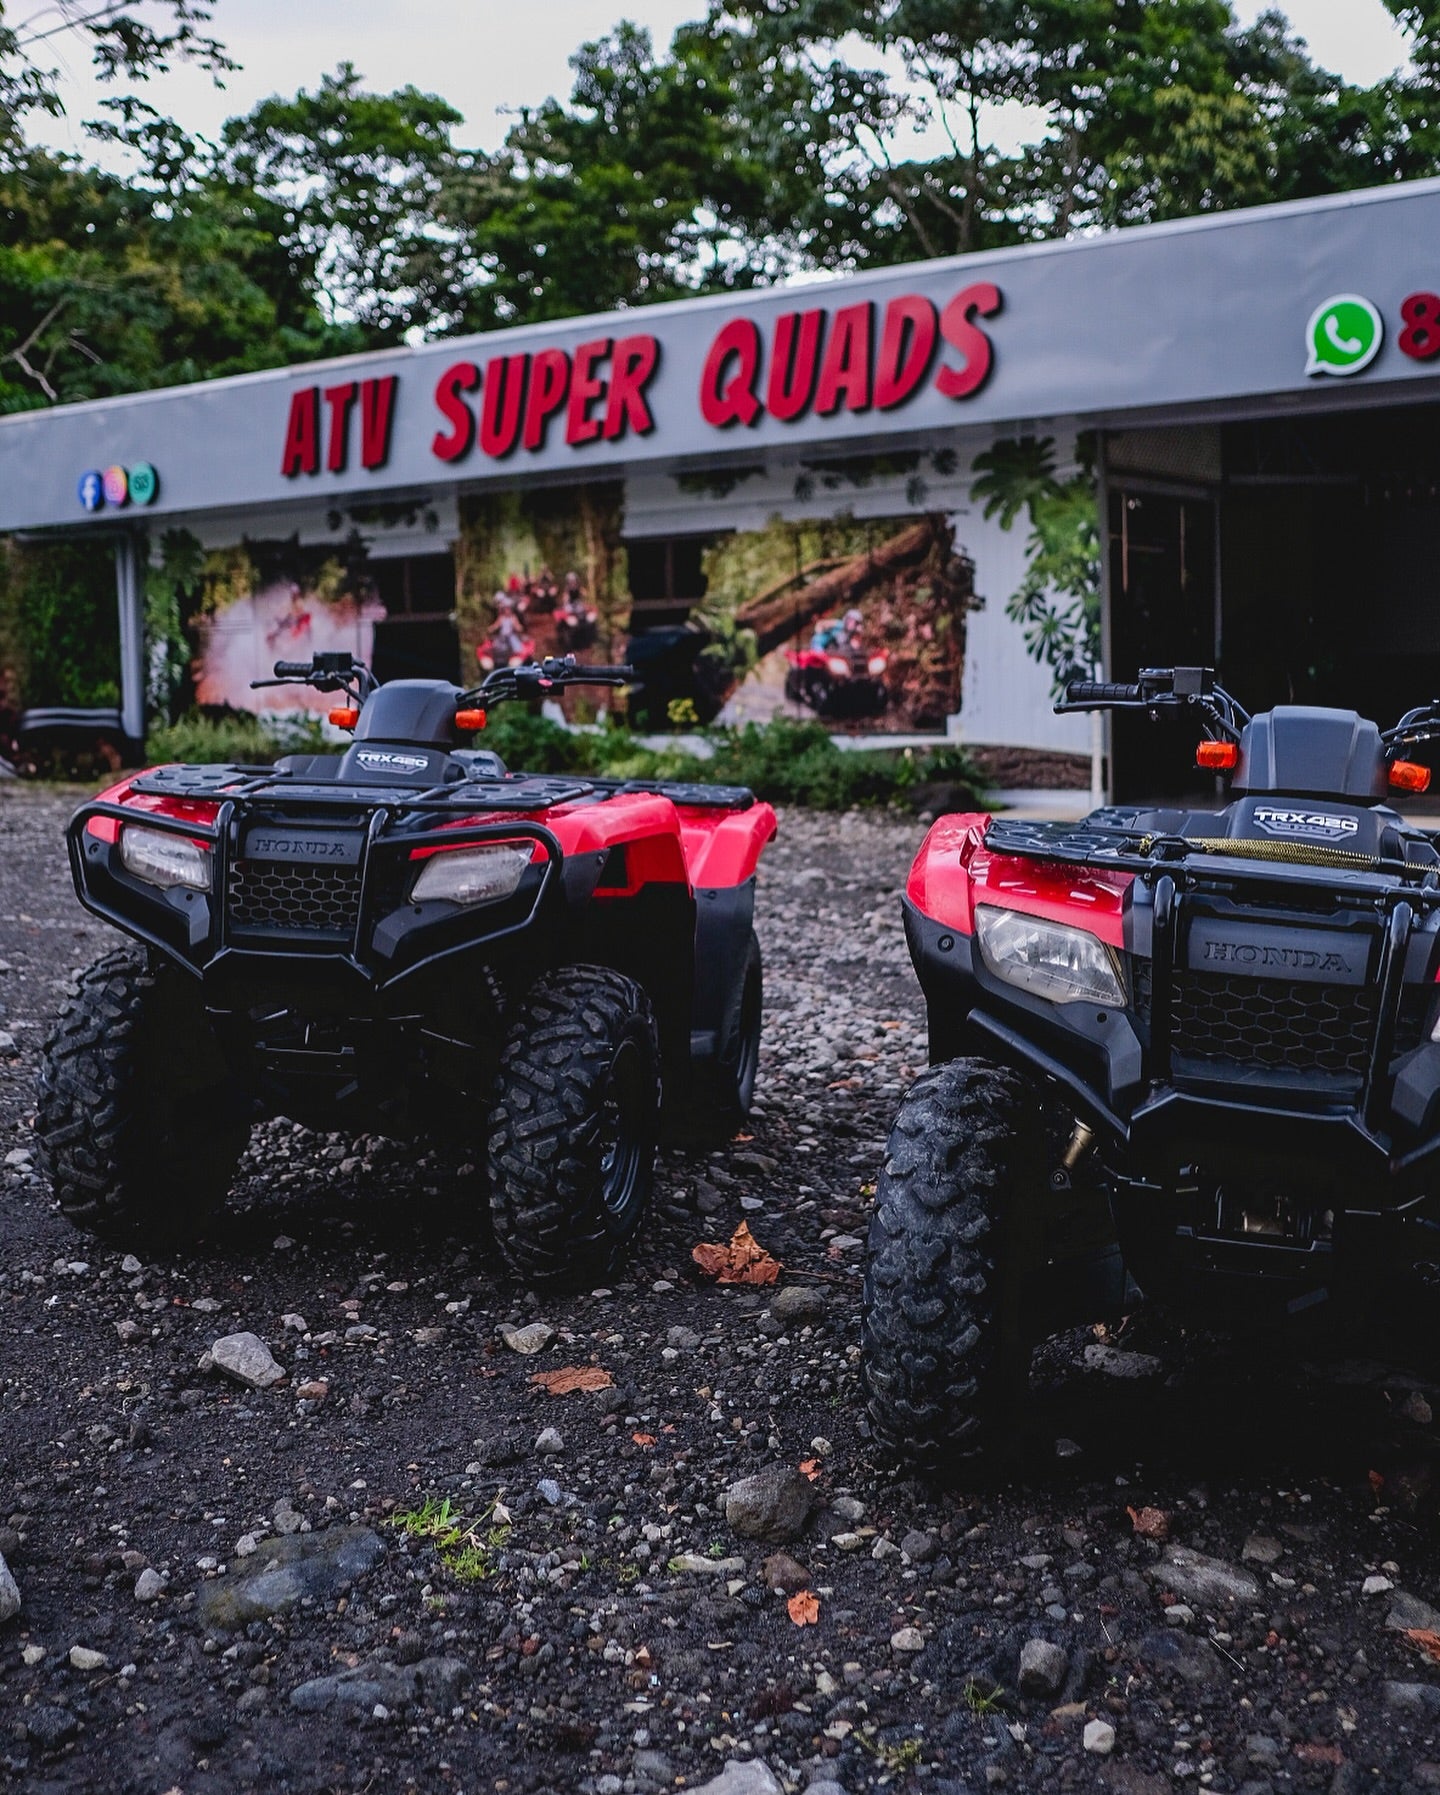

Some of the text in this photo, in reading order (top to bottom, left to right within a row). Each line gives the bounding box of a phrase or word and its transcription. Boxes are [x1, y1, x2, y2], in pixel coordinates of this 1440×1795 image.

[281, 283, 1001, 476] ATV SUPER QUADS
[357, 753, 428, 768] TRX420
[1253, 811, 1358, 832] TRX420
[255, 839, 351, 856] HONDA
[1204, 941, 1352, 973] HONDA
